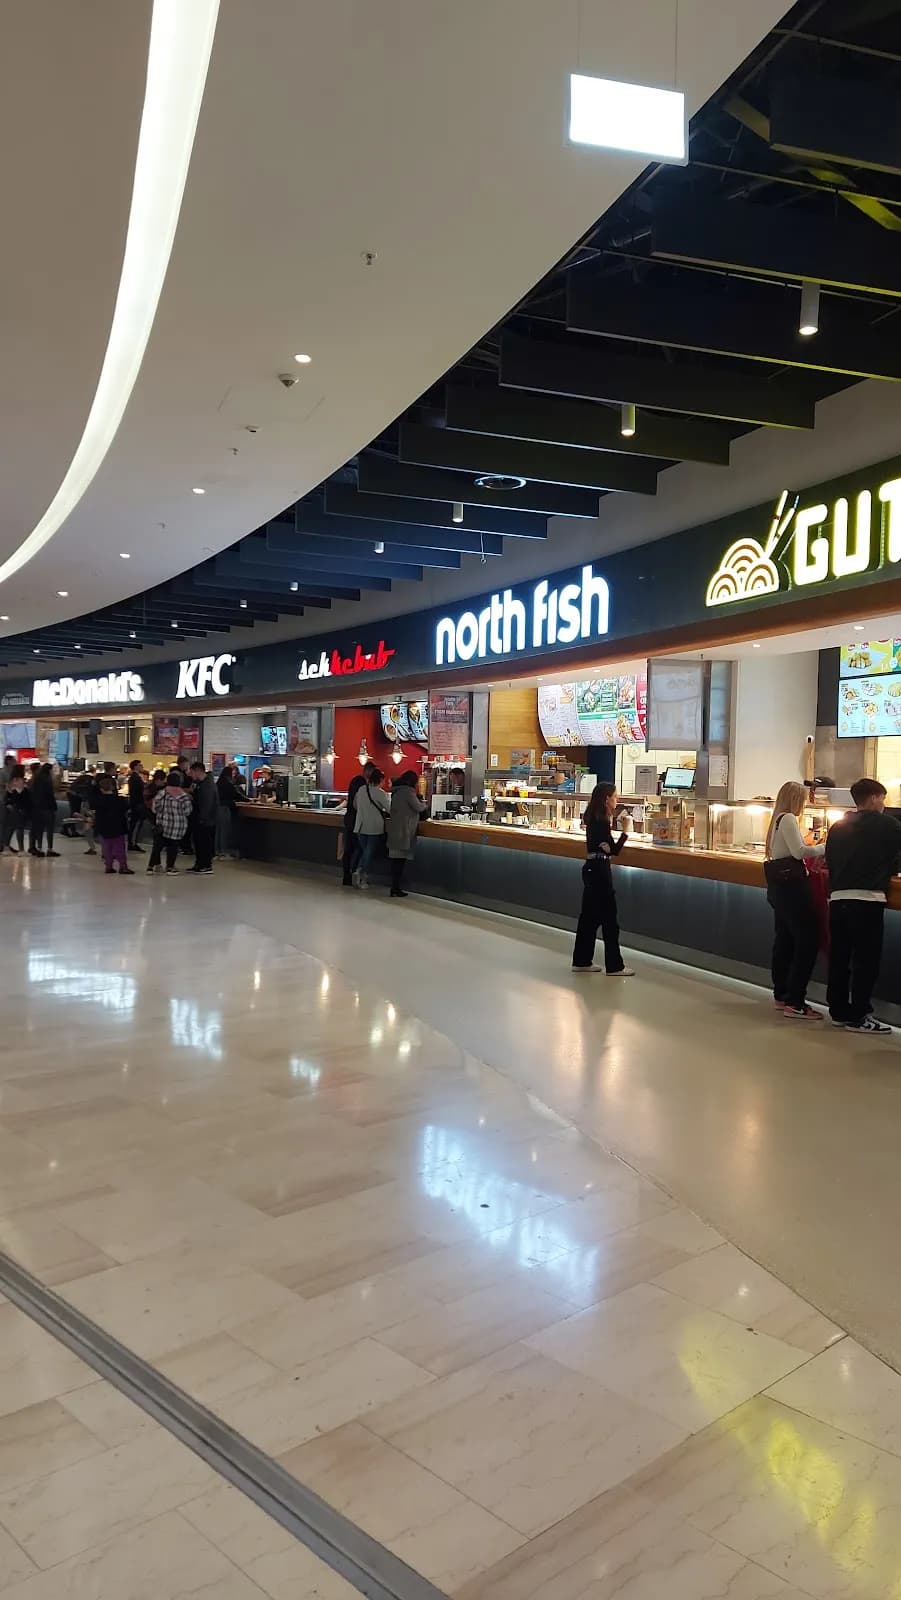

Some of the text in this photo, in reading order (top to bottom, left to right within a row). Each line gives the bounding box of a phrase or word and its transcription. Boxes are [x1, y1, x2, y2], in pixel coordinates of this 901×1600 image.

[436, 565, 609, 665] north fish
[32, 670, 144, 707] McDonald's
[176, 654, 233, 699] KFC
